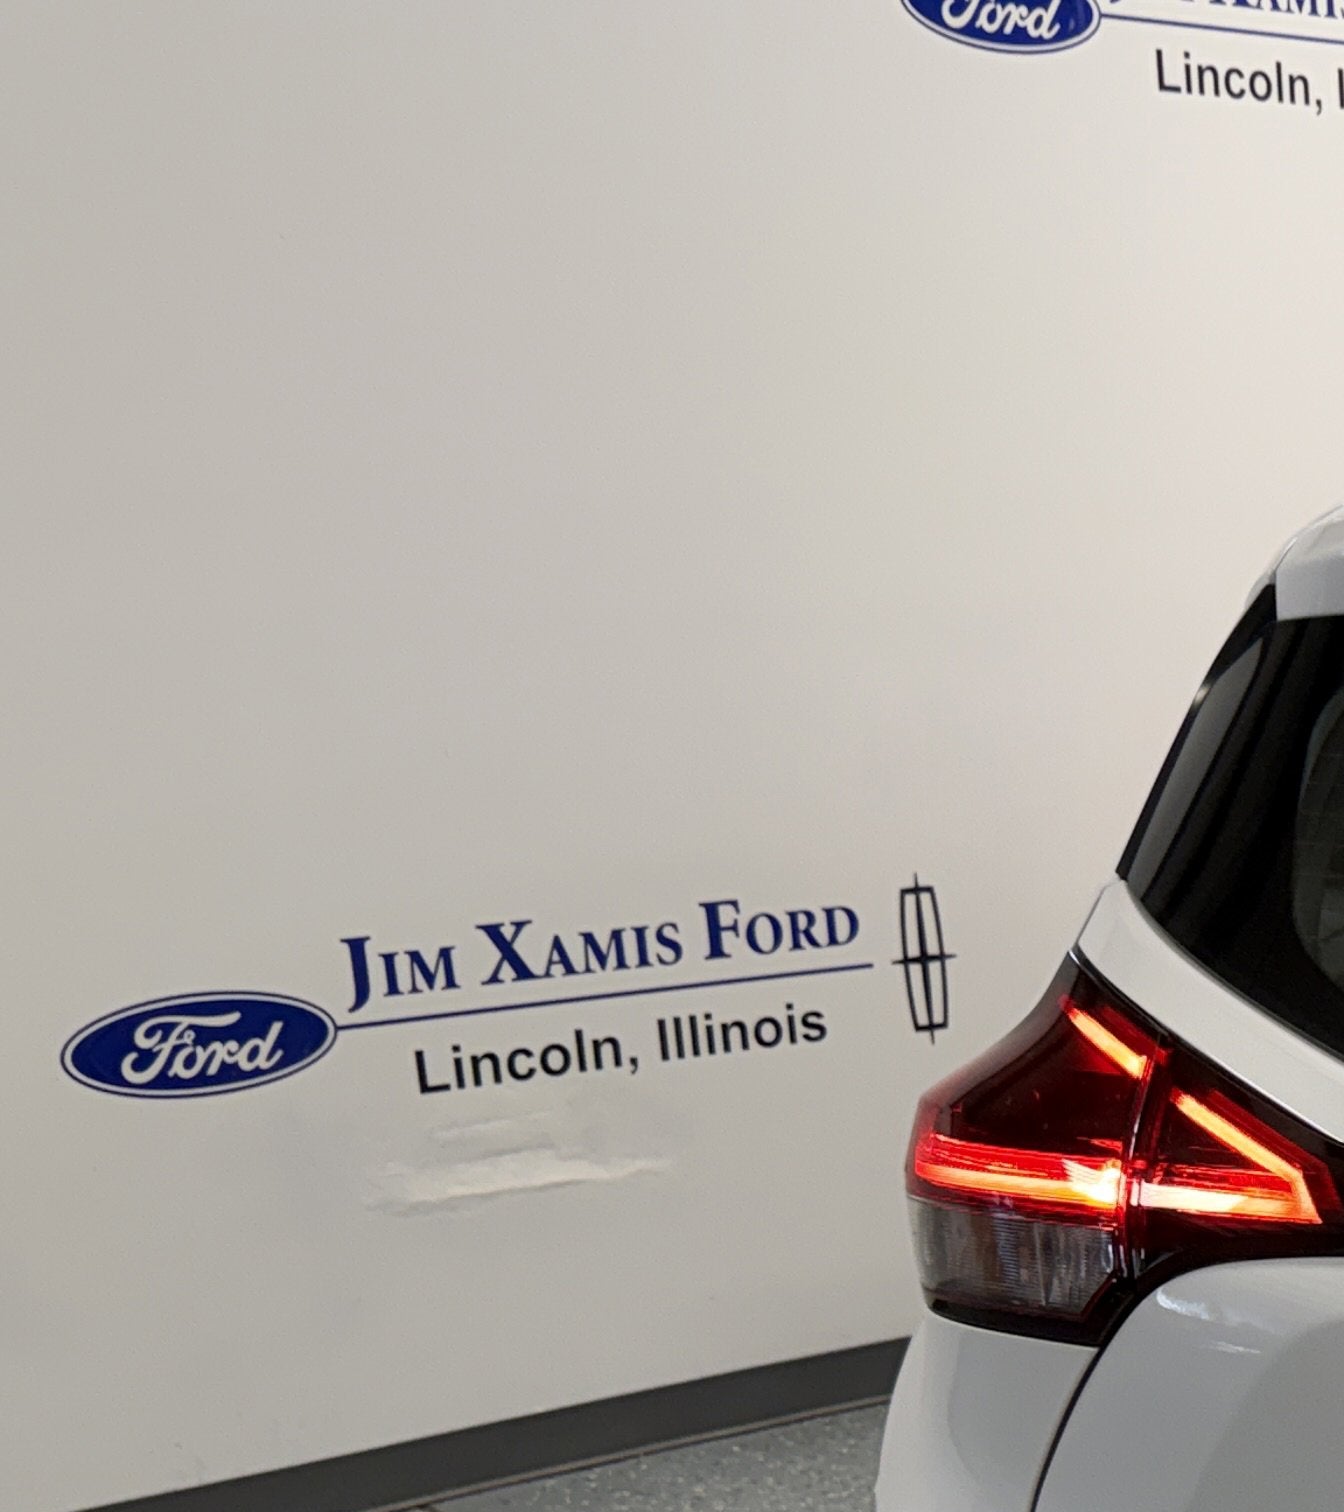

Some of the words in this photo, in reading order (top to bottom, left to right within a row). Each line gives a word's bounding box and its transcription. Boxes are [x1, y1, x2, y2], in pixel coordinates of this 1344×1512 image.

[1155, 48, 1323, 116] Lincoln,
[340, 936, 461, 1012] JIM
[476, 920, 685, 986] XAMIS
[698, 900, 860, 959] FORD
[119, 1010, 285, 1086] Ford
[414, 1030, 641, 1094] Lincoln,
[658, 1002, 829, 1062] Illinois
